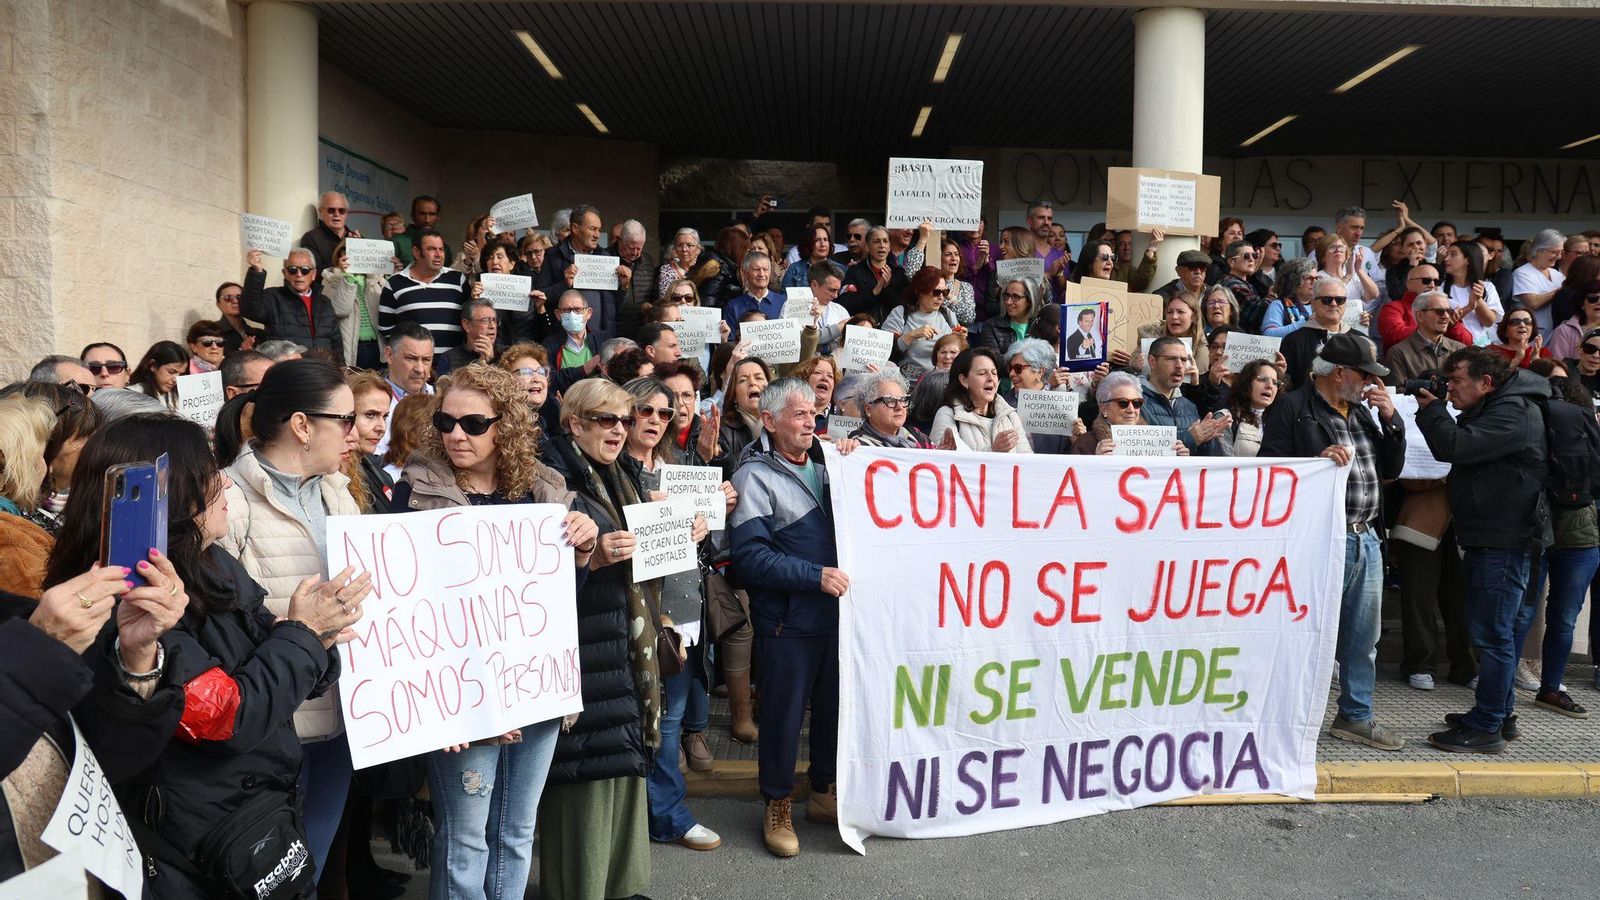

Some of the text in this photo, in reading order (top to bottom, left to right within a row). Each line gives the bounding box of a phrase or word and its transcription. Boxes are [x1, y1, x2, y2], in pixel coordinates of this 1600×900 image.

[1360, 159, 1600, 213] EXTERNA
[243, 216, 290, 231] QUEREMOS UN
[889, 215, 980, 225] COLAPSAN URGENCIAS
[248, 233, 281, 245] UNA NAVE
[276, 230, 288, 238] NO
[349, 248, 394, 256] PROFESIONALES
[1129, 298, 1161, 325] SOS
[746, 321, 796, 334] CUIDAMOS DE
[868, 331, 878, 339] SIN
[775, 340, 798, 350] CUIDA
[848, 338, 892, 350] PROFESIONALES
[1250, 338, 1262, 346] SIN
[852, 347, 860, 355] SE
[861, 349, 877, 357] CAEN
[1228, 344, 1278, 354] PROFESIONALES
[1232, 352, 1240, 360] SE
[202, 378, 211, 390] SIN
[1022, 393, 1063, 402] QUEREMOS
[191, 412, 202, 423] SE
[1026, 421, 1068, 429] INDUSTRIAL
[1116, 429, 1160, 437] QUEREMOS
[666, 471, 719, 482] QUEREMOS UN
[705, 485, 716, 494] NO
[865, 460, 1298, 533] CON LA SALUD
[660, 507, 673, 518] SIN
[634, 517, 694, 536] PROFESIONALES
[640, 533, 688, 553] SE CAEN LOS
[344, 512, 561, 600] NO SOMOS
[644, 549, 687, 568] HOSPITALES
[939, 557, 1308, 629] NO SE JUEGA,
[347, 580, 547, 673] MÁQUINAS
[895, 648, 1247, 728] NI SE VENDE,
[350, 646, 581, 749] SOMOS PERSONAS
[885, 732, 1268, 820] NI SE NEGOCIA
[253, 839, 304, 896] Reebok
